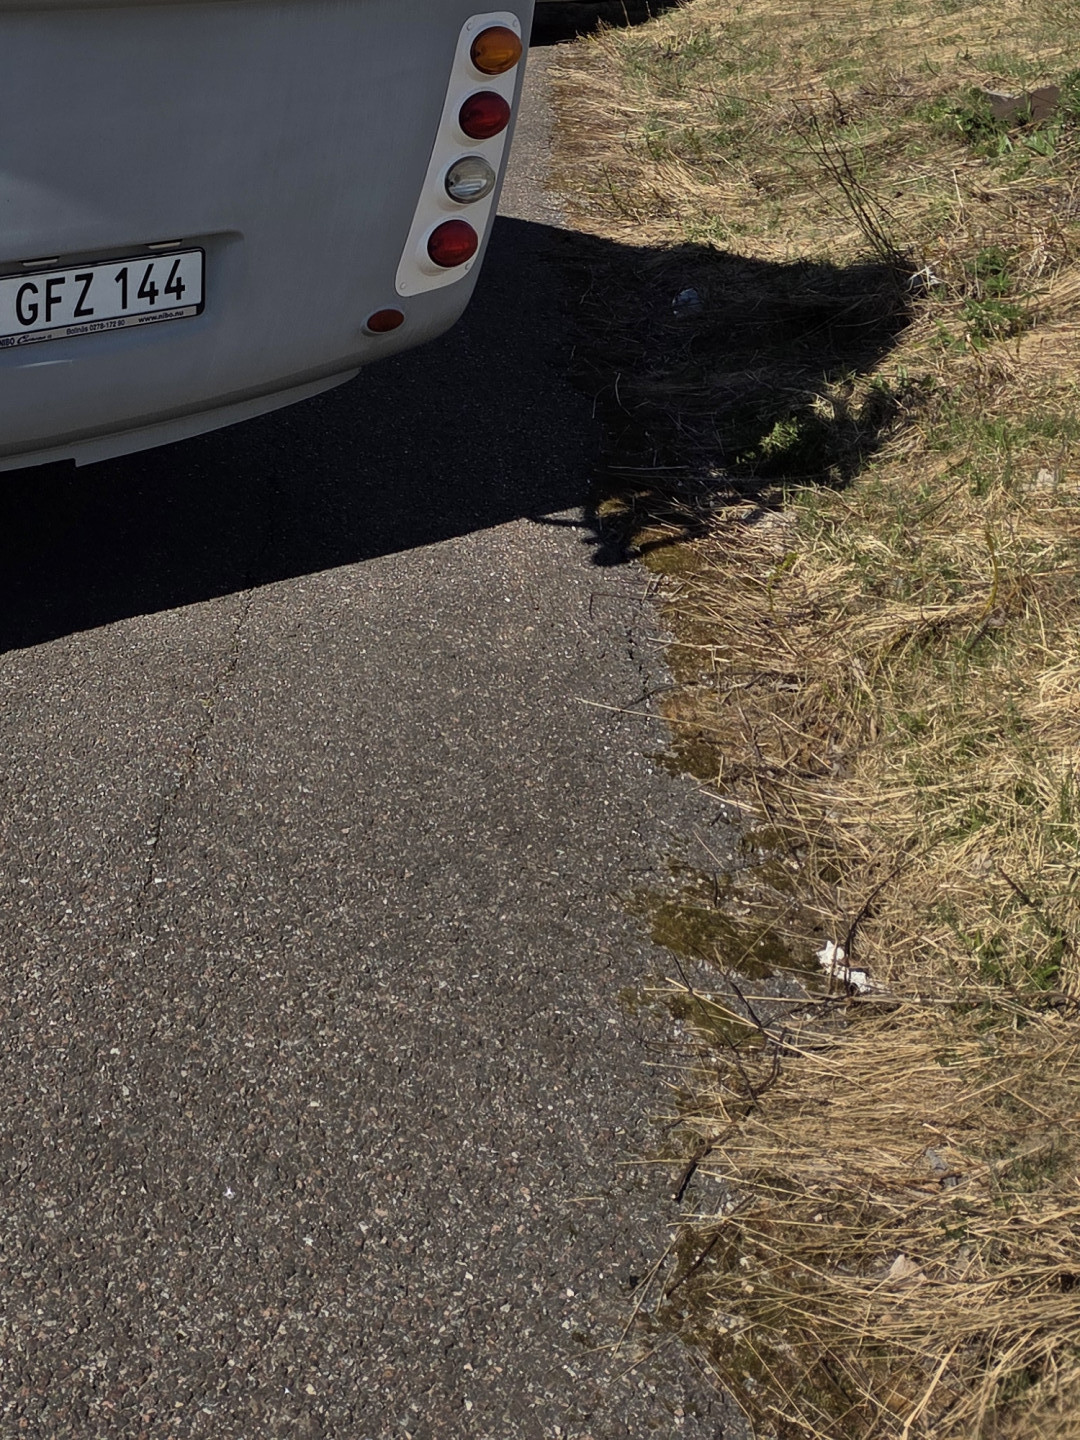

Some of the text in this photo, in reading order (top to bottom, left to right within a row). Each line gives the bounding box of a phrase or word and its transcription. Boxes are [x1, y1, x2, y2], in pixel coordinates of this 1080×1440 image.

[15, 259, 186, 326] GFZ 144
[138, 310, 184, 323] www.nibo.nu
